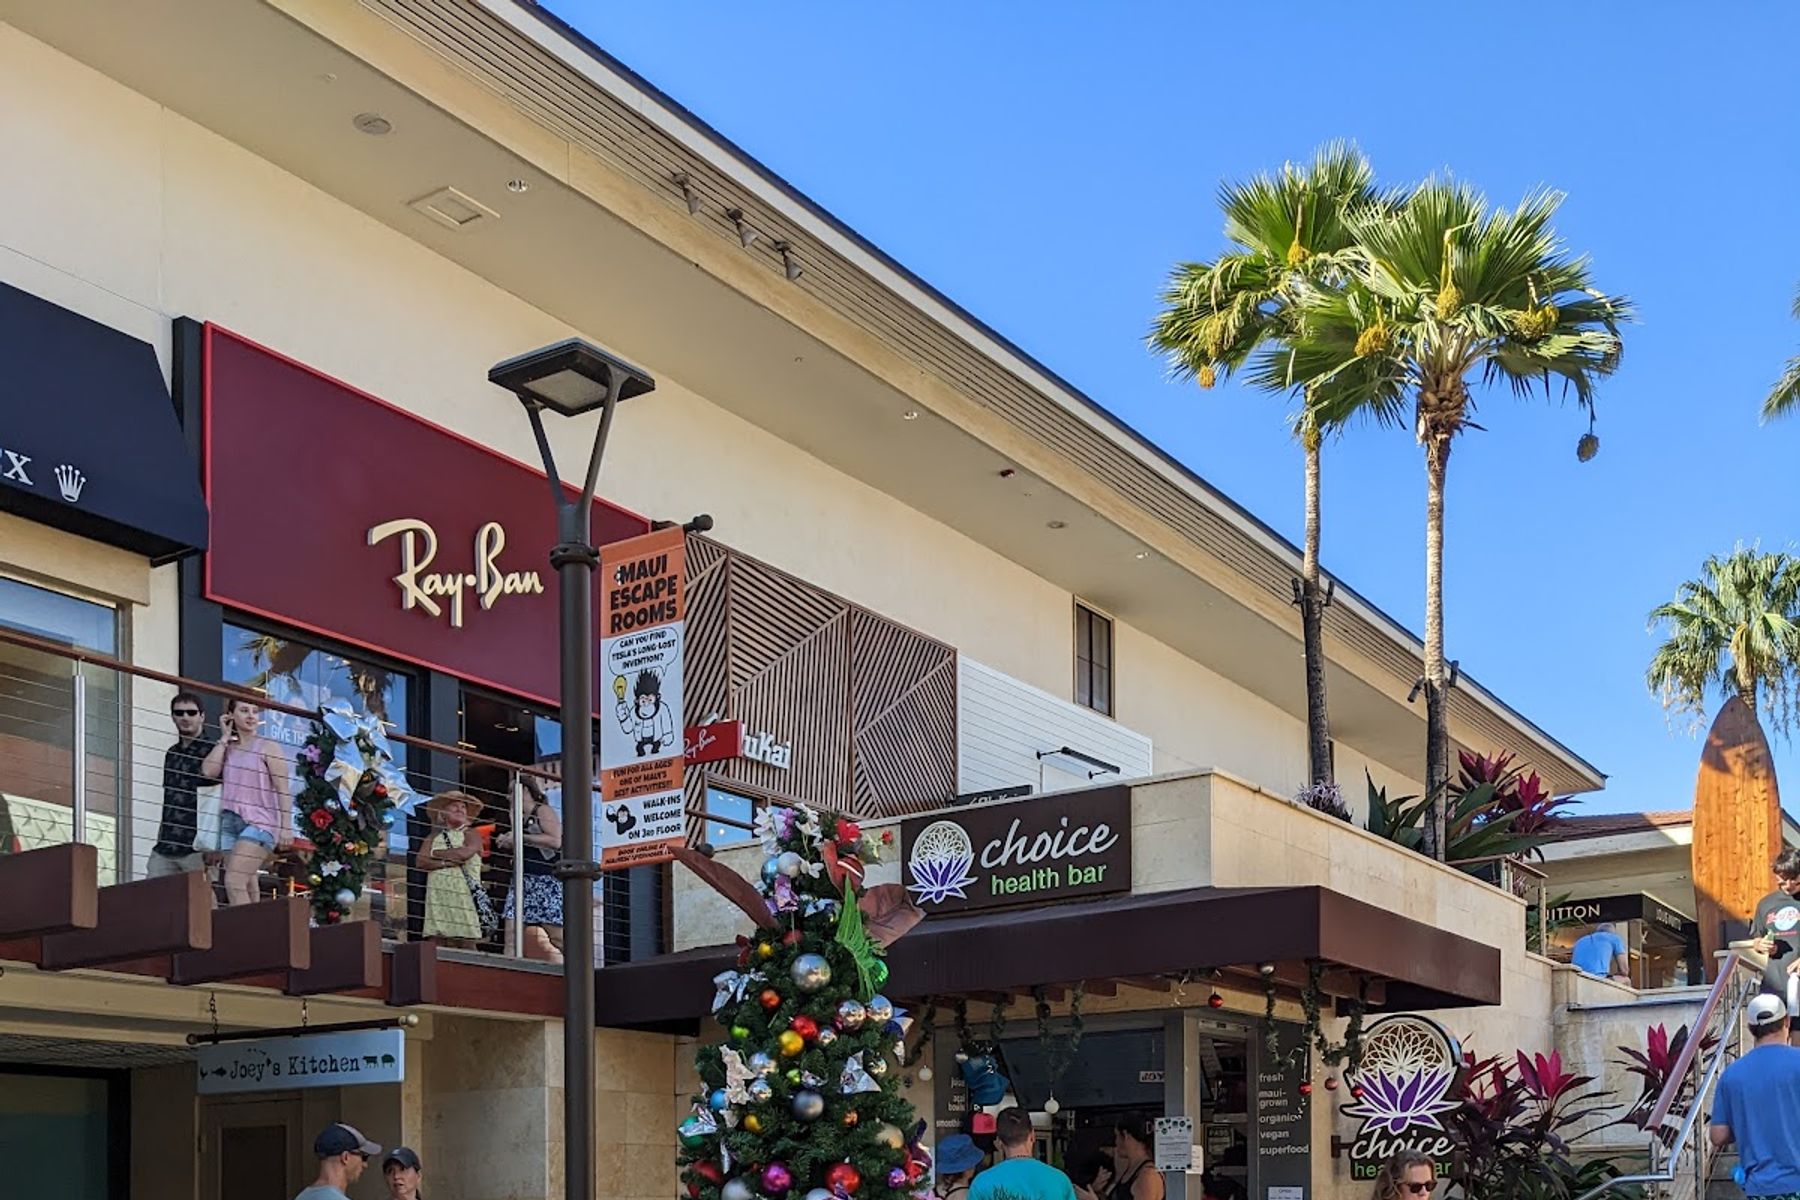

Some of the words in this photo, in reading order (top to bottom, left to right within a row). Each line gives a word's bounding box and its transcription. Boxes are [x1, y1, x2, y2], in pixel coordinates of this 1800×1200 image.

[618, 554, 668, 586] MAUI
[610, 574, 678, 611] ESCAPE
[610, 599, 678, 634] ROOMS
[619, 638, 635, 648] CAN
[635, 634, 648, 645] YOU
[649, 630, 667, 641] FIND
[612, 647, 637, 661] TESLA'S
[622, 653, 664, 669] INVENTION?
[271, 725, 291, 741] GIVE
[627, 765, 640, 775] FOR
[640, 763, 653, 772] ALL
[619, 777, 632, 786] ONE
[633, 775, 641, 783] OF
[614, 787, 629, 798] BEST
[643, 794, 681, 810] WALK-INS
[643, 808, 682, 823] WELCOME
[628, 830, 640, 839] ON
[656, 823, 682, 835] FLOOR
[980, 816, 1118, 869] choice
[991, 867, 1059, 895] health
[1067, 864, 1107, 886] bar
[230, 1058, 280, 1082] Joey's
[288, 1054, 360, 1076] Kitchen
[1260, 1072, 1284, 1083] fresh
[1259, 1087, 1287, 1098] maui-
[1259, 1098, 1289, 1109] grown
[1259, 1112, 1296, 1125] organic
[1260, 1130, 1290, 1140] vegan
[1259, 1143, 1309, 1156] superfood
[1351, 1128, 1456, 1159] choice
